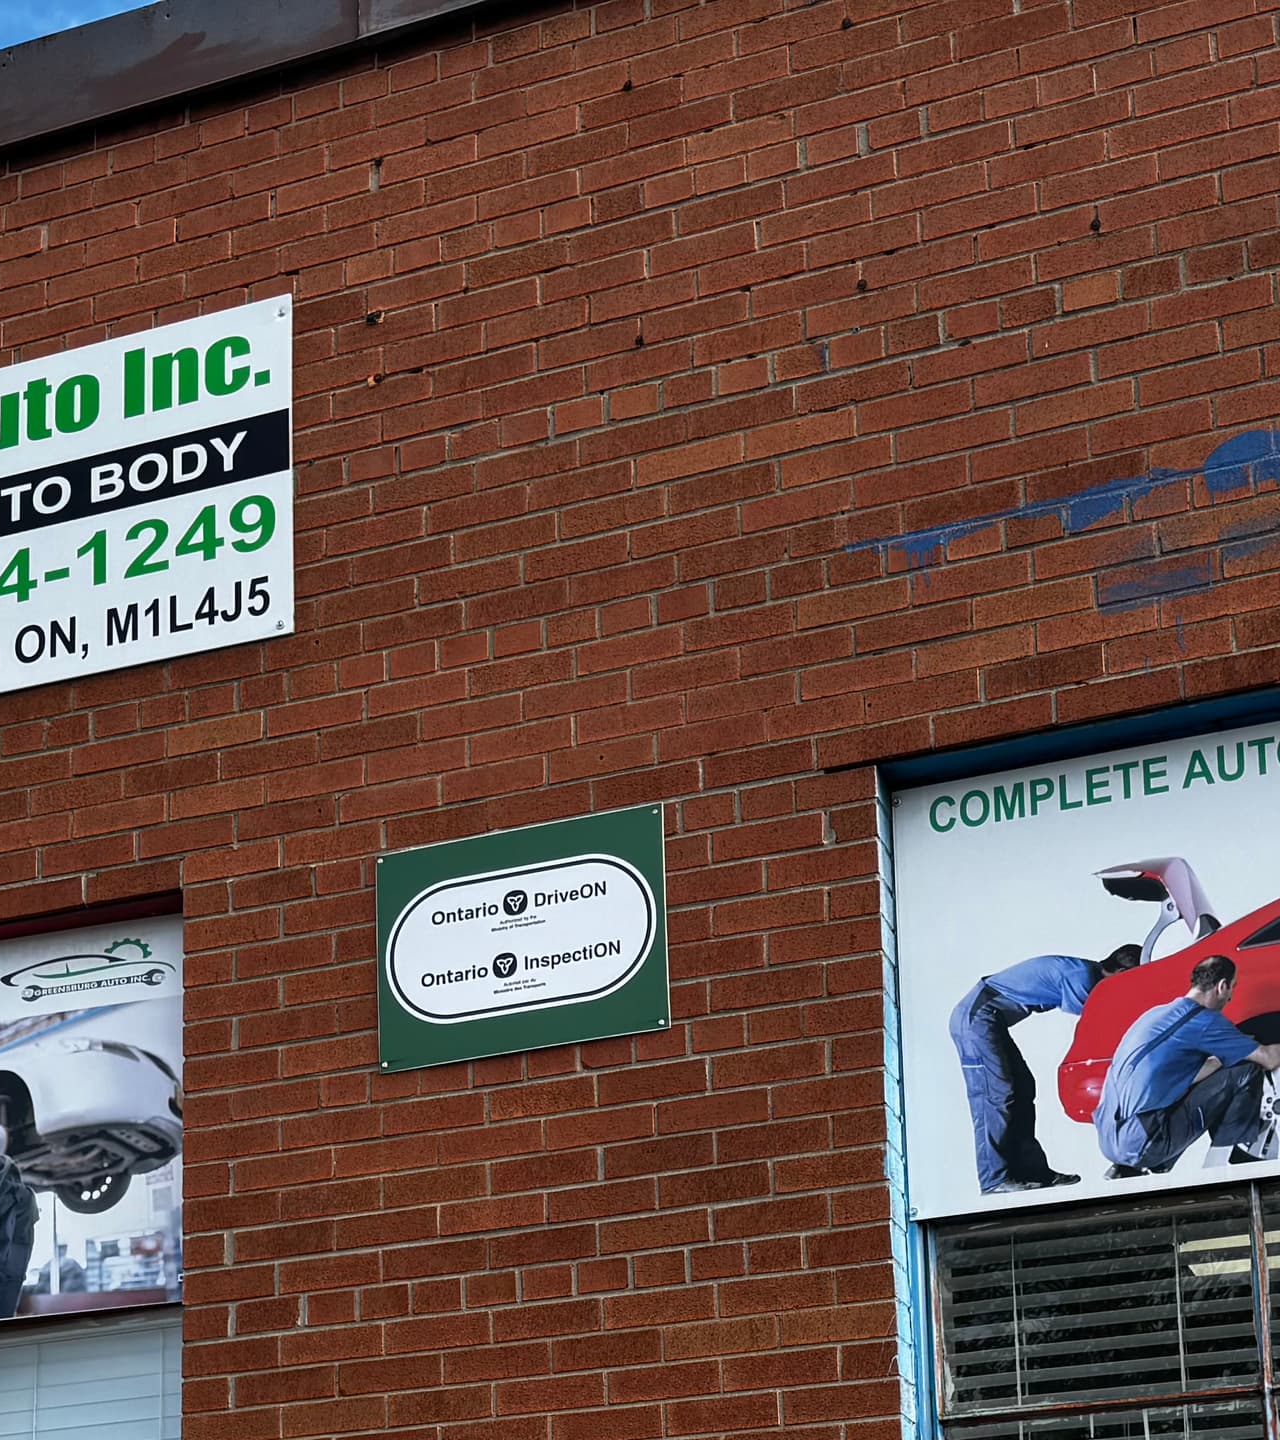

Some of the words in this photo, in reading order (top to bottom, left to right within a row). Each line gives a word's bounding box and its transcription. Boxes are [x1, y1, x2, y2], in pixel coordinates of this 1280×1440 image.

[124, 335, 271, 419] Inc.
[90, 431, 249, 504] BODY
[14, 616, 90, 664] ON,
[106, 576, 271, 648] M1L4J5
[929, 756, 1169, 834] COMPLETE
[431, 901, 499, 926] Ontario
[534, 881, 608, 907] DriveON
[34, 982, 98, 997] GREENSBURG
[100, 977, 128, 988] AUTO
[421, 962, 489, 988] Ontario
[524, 940, 621, 972] InspectiON
